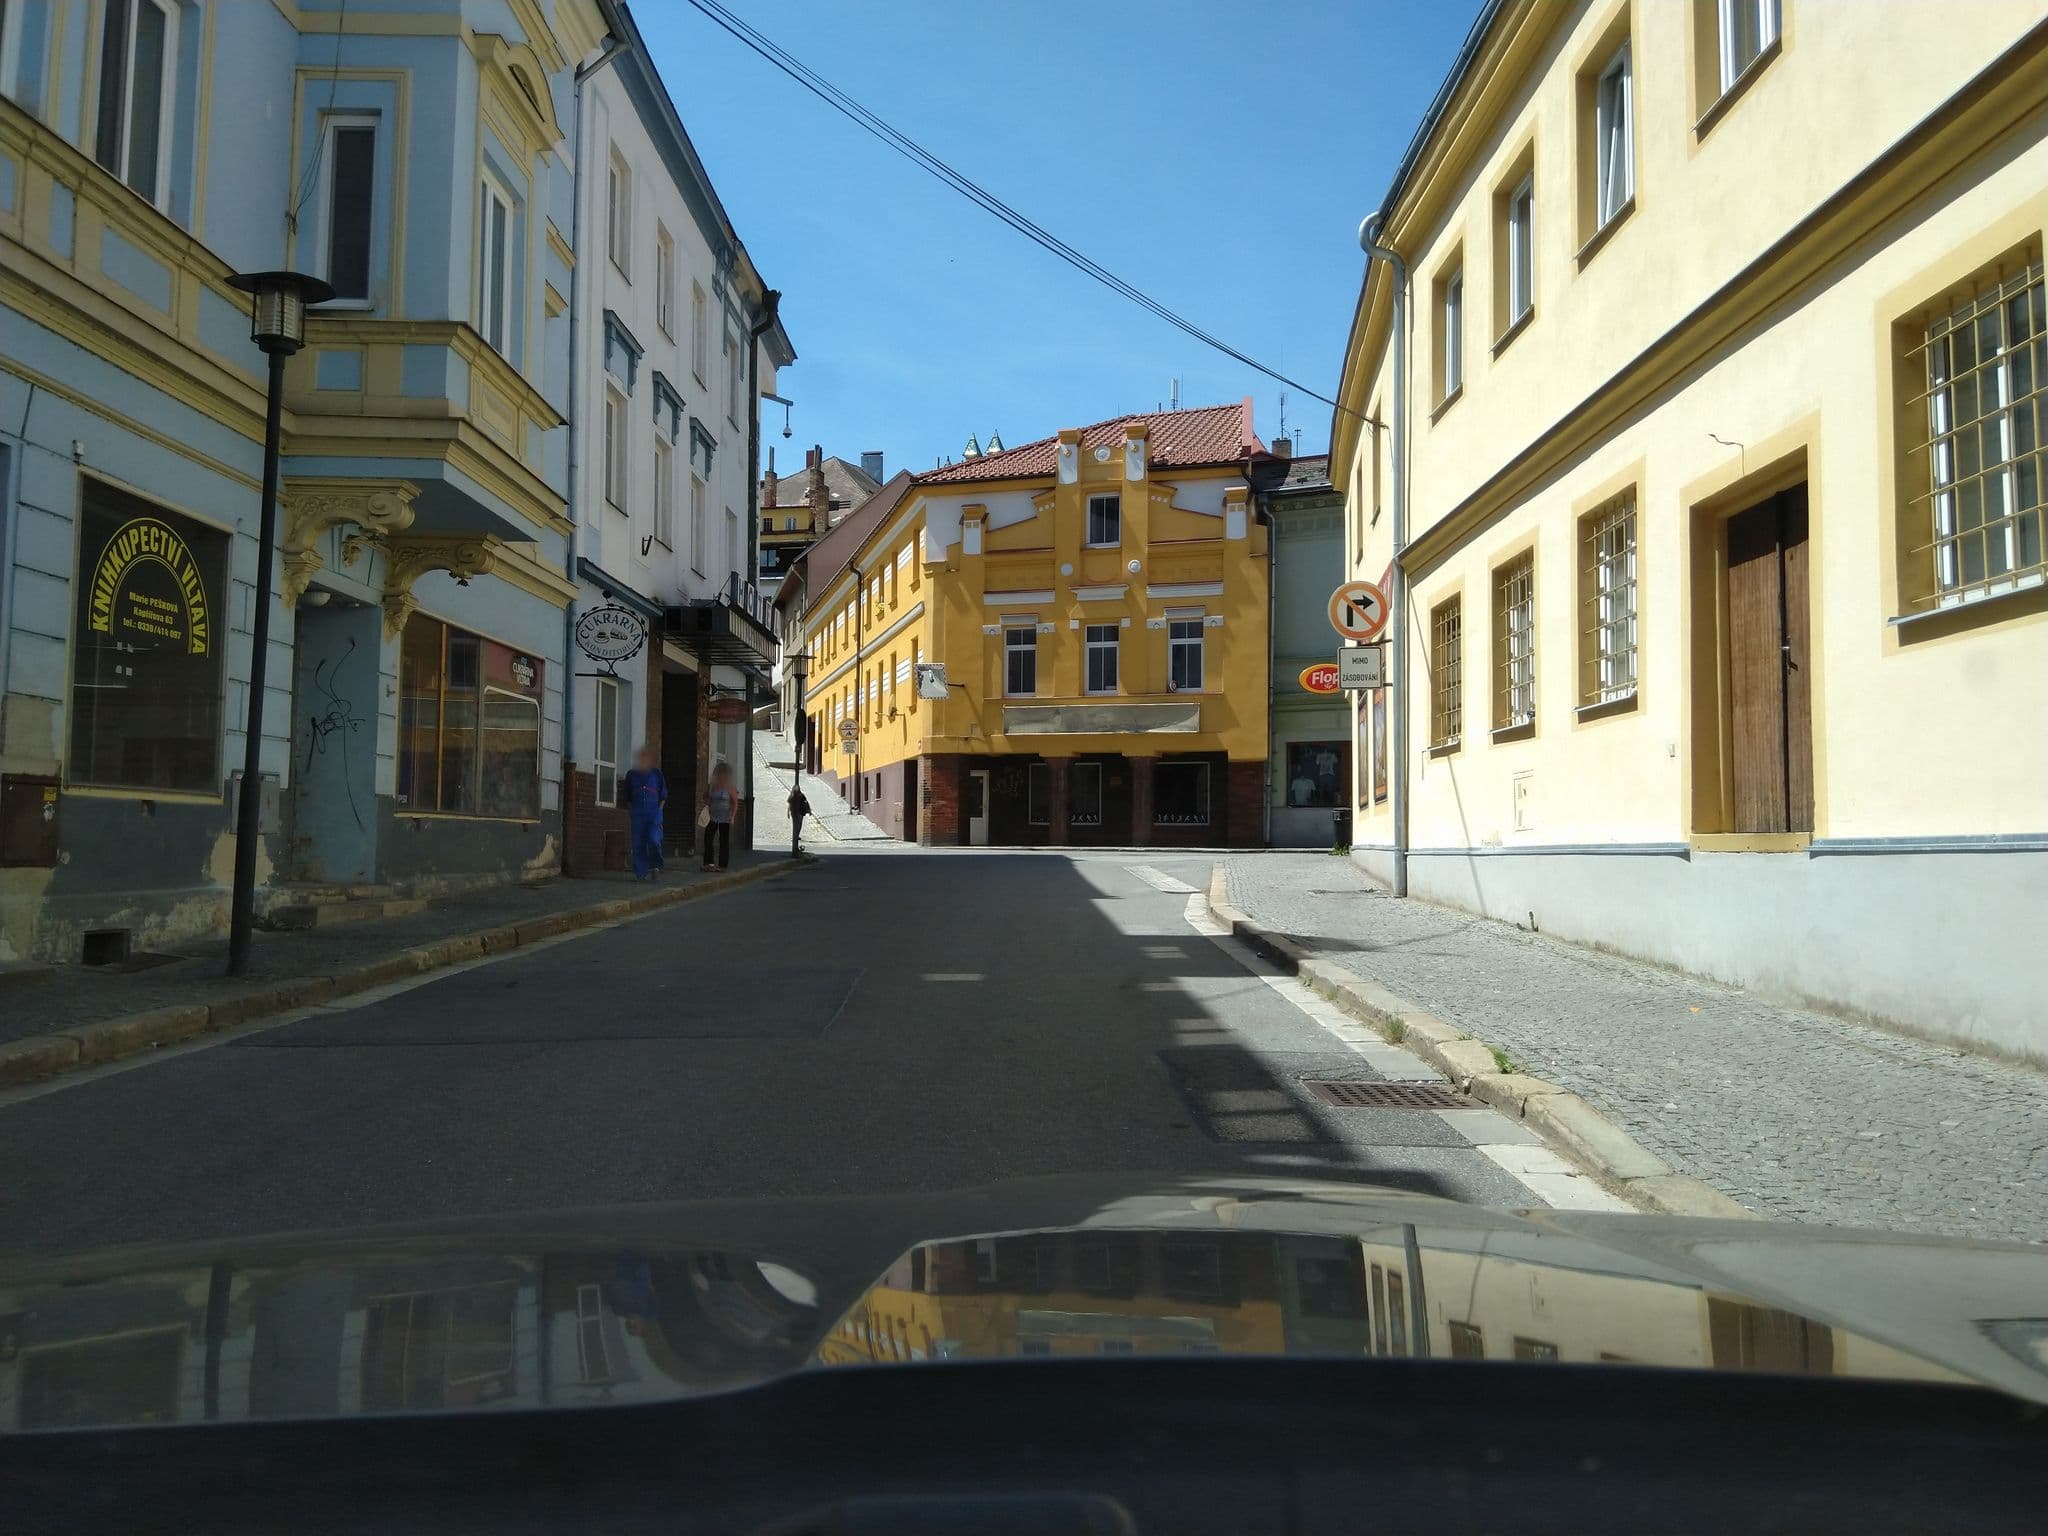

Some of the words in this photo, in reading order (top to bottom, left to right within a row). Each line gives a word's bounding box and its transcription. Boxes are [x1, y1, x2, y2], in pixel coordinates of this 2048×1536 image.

[93, 525, 184, 632] KNIHKUPECTVÍ
[181, 562, 206, 654] VLTAVA
[129, 591, 149, 605] Marie
[737, 575, 781, 642] HOTEL
[580, 612, 641, 642] CUKRÁRNA
[1351, 656, 1369, 665] MIMO
[1342, 671, 1379, 682] ZÁSOBOVÁNÍ
